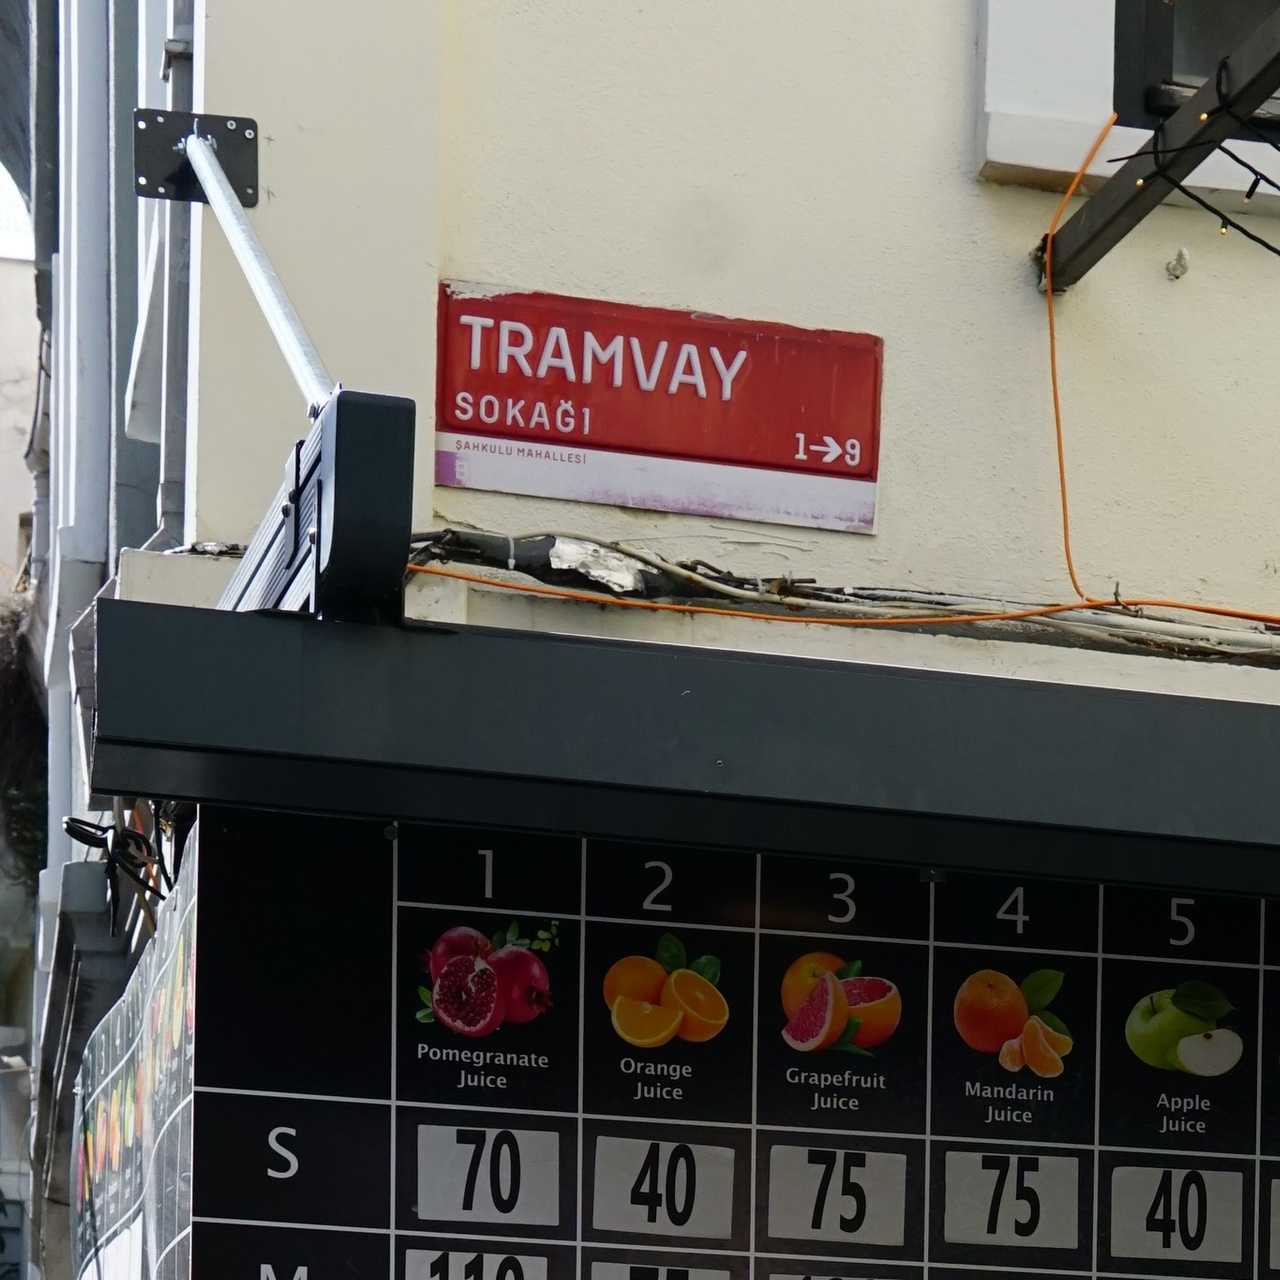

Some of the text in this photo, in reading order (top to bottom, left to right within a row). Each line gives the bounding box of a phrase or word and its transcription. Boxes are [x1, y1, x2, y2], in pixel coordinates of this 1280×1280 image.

[459, 315, 746, 401] TRAMVAY
[454, 391, 590, 435] SOKAĞI
[455, 440, 586, 464] ŞAHKULU MAHALLESİ
[795, 433, 861, 466] 1 9
[478, 850, 492, 898] 1
[643, 861, 672, 911] 2
[828, 873, 856, 923] 3
[997, 887, 1029, 933] 4
[1170, 898, 1195, 945] 5
[418, 1044, 548, 1067] Pomegranate
[620, 1058, 691, 1079] Orange
[457, 1070, 506, 1088] Juice
[634, 1082, 682, 1099] Juice
[786, 1068, 885, 1092] Grapefruit
[811, 1093, 858, 1109] Juice
[966, 1082, 1053, 1101] Mandarin
[985, 1106, 1032, 1122] Juice
[1157, 1094, 1210, 1112] Apple
[1159, 1116, 1205, 1132] Juice
[268, 1127, 298, 1178] S
[455, 1130, 520, 1214] 70
[630, 1144, 695, 1227] 40
[807, 1150, 866, 1233] 75
[982, 1156, 1040, 1237] 75
[1146, 1169, 1206, 1252] 40
